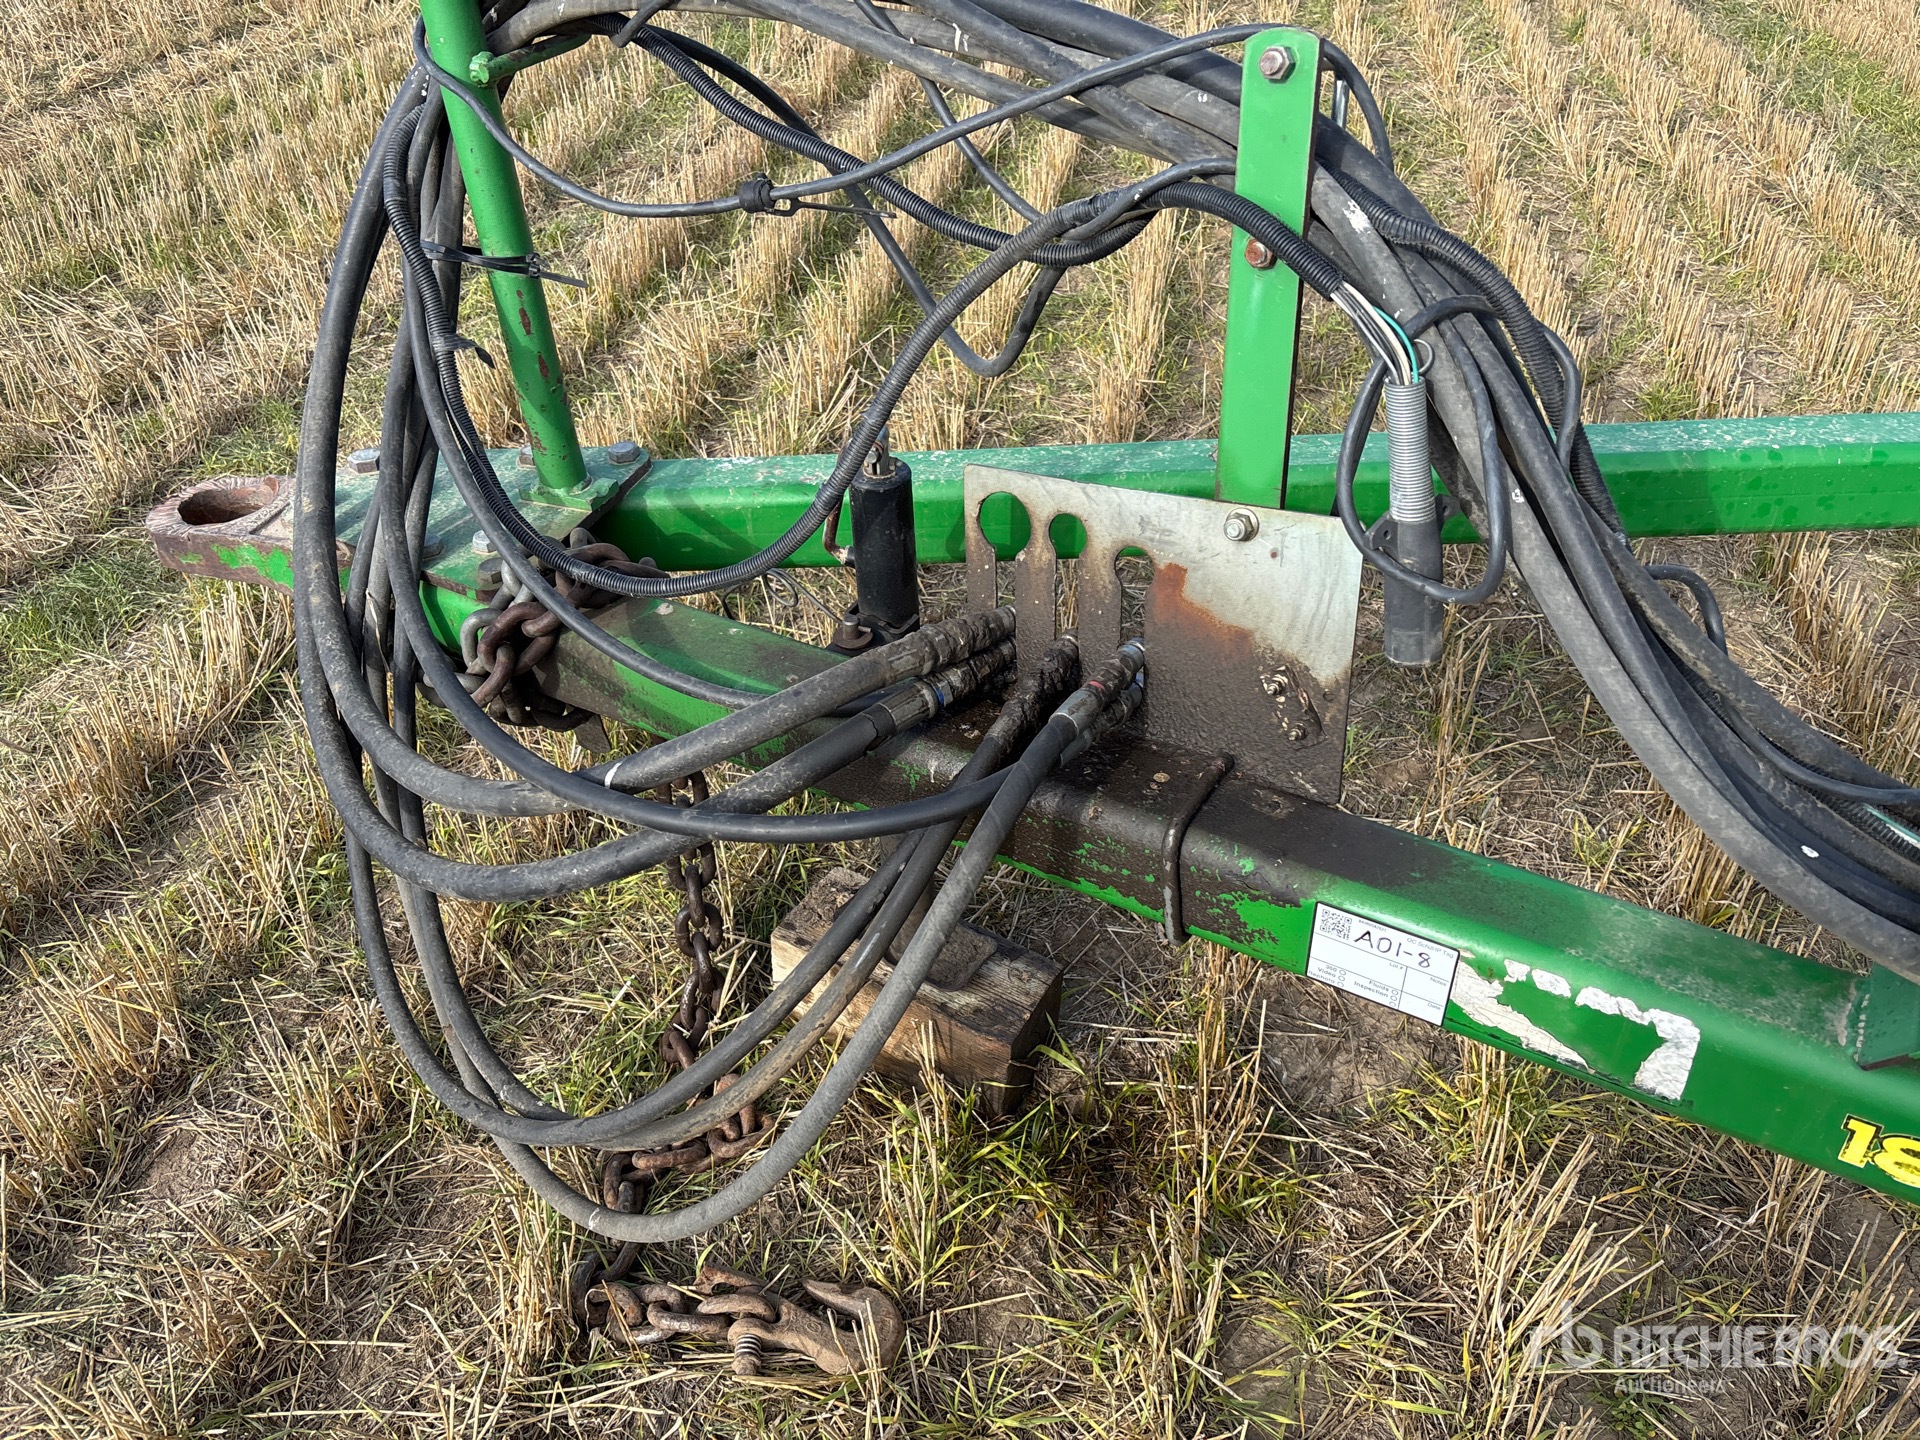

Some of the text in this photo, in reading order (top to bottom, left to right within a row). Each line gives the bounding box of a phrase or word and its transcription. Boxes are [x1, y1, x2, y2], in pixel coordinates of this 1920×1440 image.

[1353, 929, 1431, 968] A01-8
[1443, 950, 1454, 959] Tag
[1317, 966, 1336, 978] Video
[1368, 980, 1390, 992] Fluids
[1429, 976, 1447, 987] Notes
[1353, 981, 1389, 998] Inspection
[1427, 1002, 1442, 1010] Date
